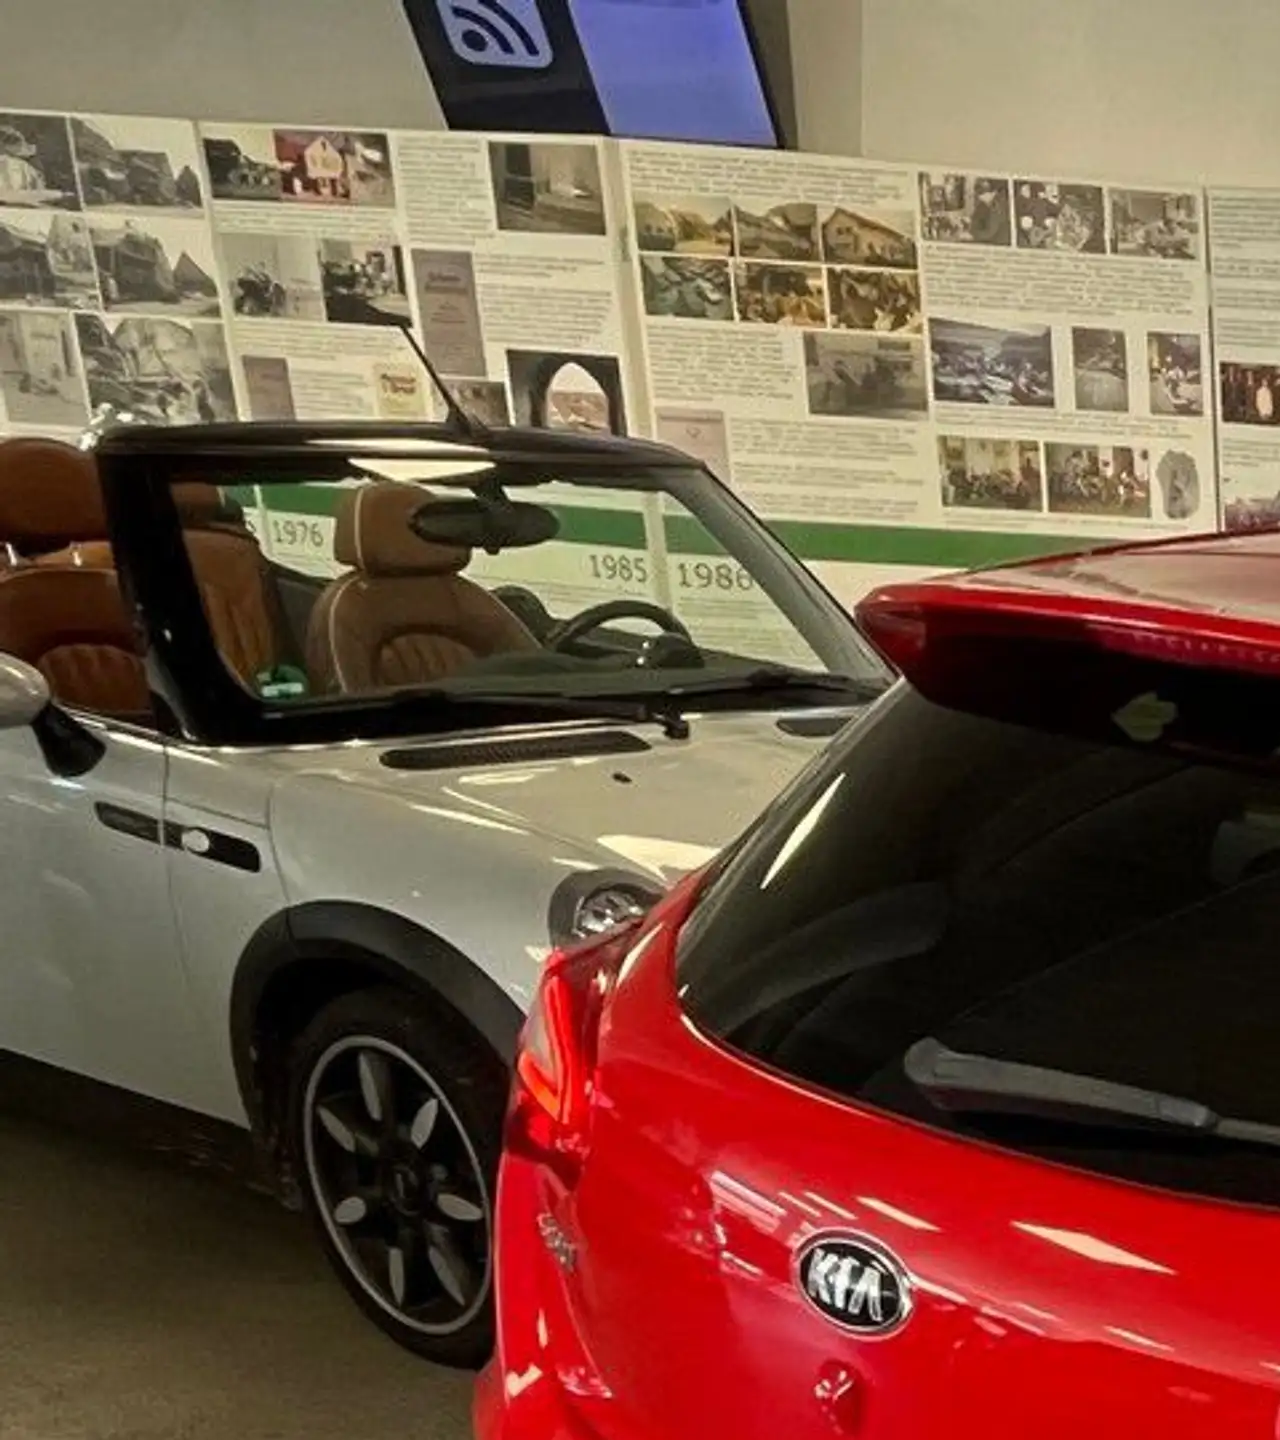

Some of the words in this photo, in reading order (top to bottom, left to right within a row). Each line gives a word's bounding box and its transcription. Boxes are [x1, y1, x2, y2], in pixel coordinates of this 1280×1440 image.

[589, 554, 648, 583] 1985
[679, 561, 754, 591] 1986
[807, 1247, 882, 1322] KIA
